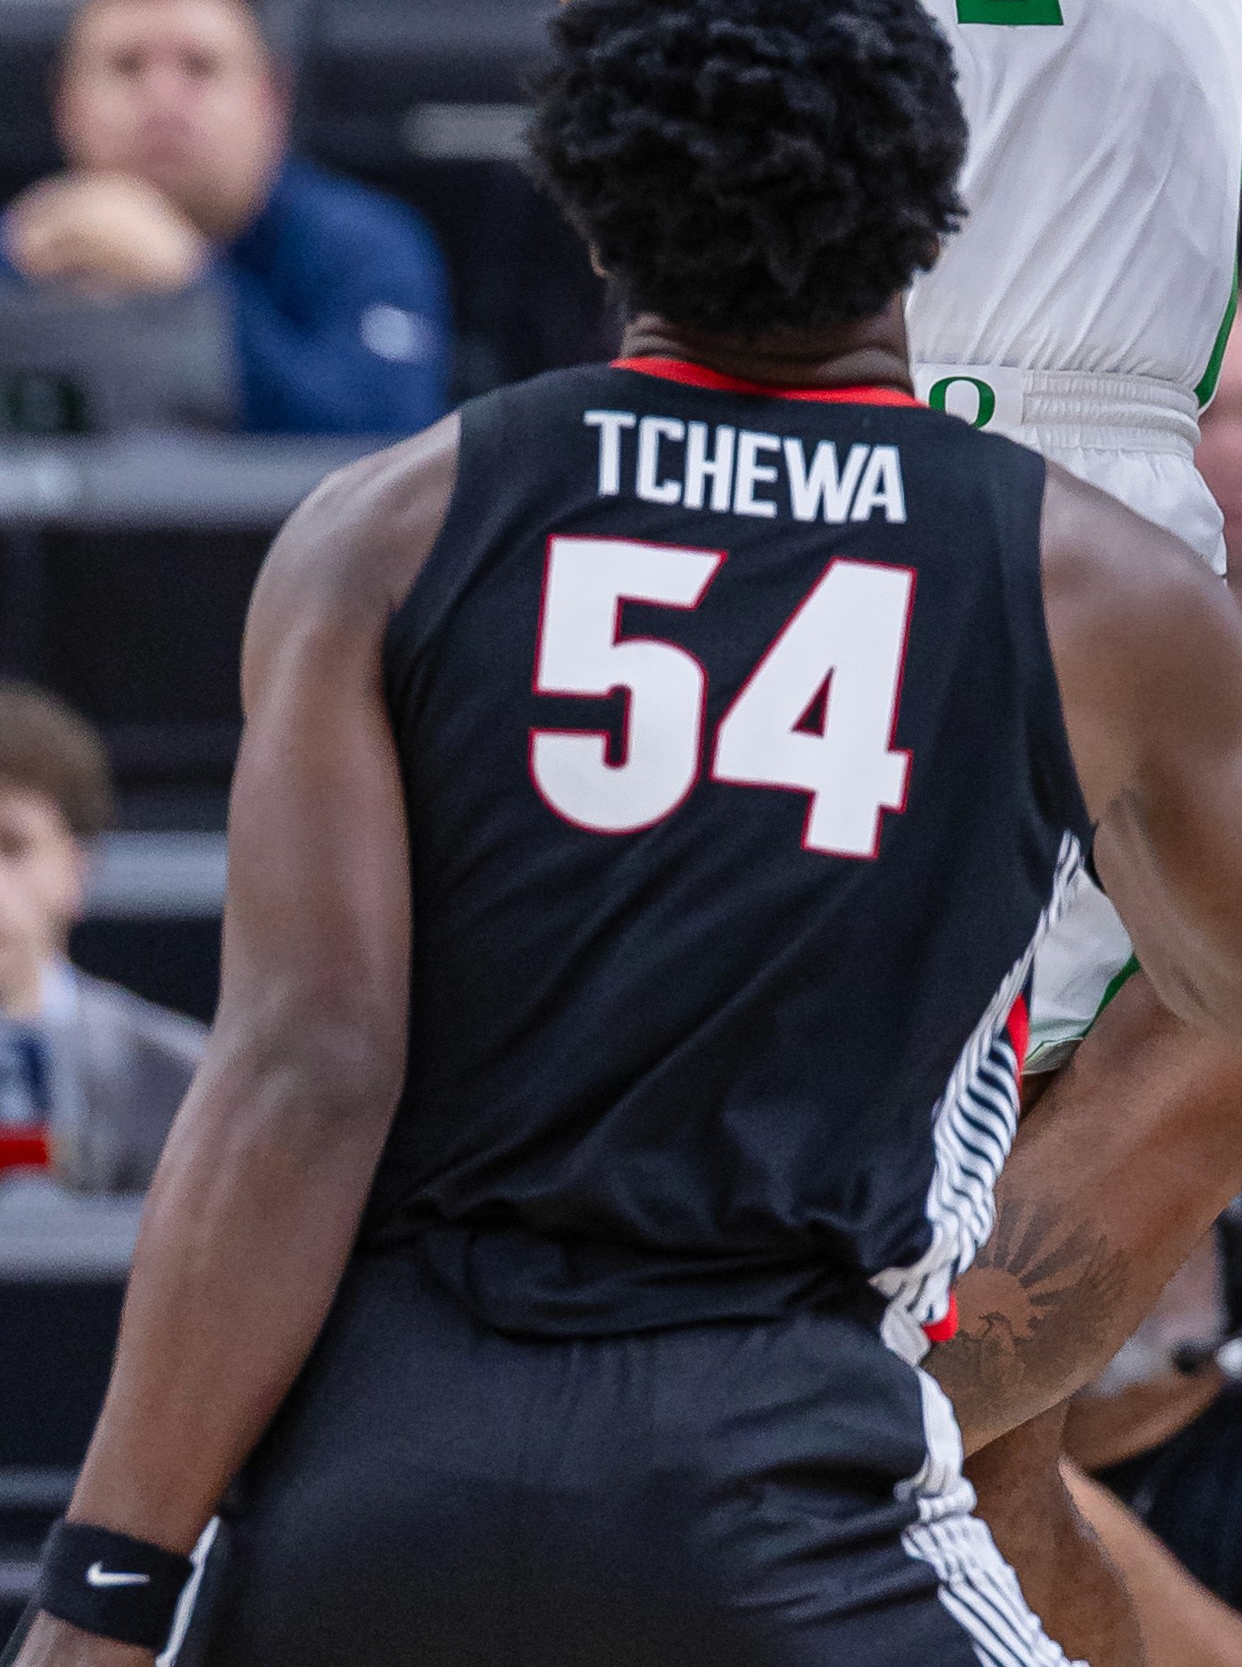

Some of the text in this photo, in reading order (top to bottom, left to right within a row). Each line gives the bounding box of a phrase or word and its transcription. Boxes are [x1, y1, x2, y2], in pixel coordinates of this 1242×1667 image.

[929, 375, 997, 430] O
[583, 409, 907, 524] TCHEWA
[528, 534, 917, 861] 54
